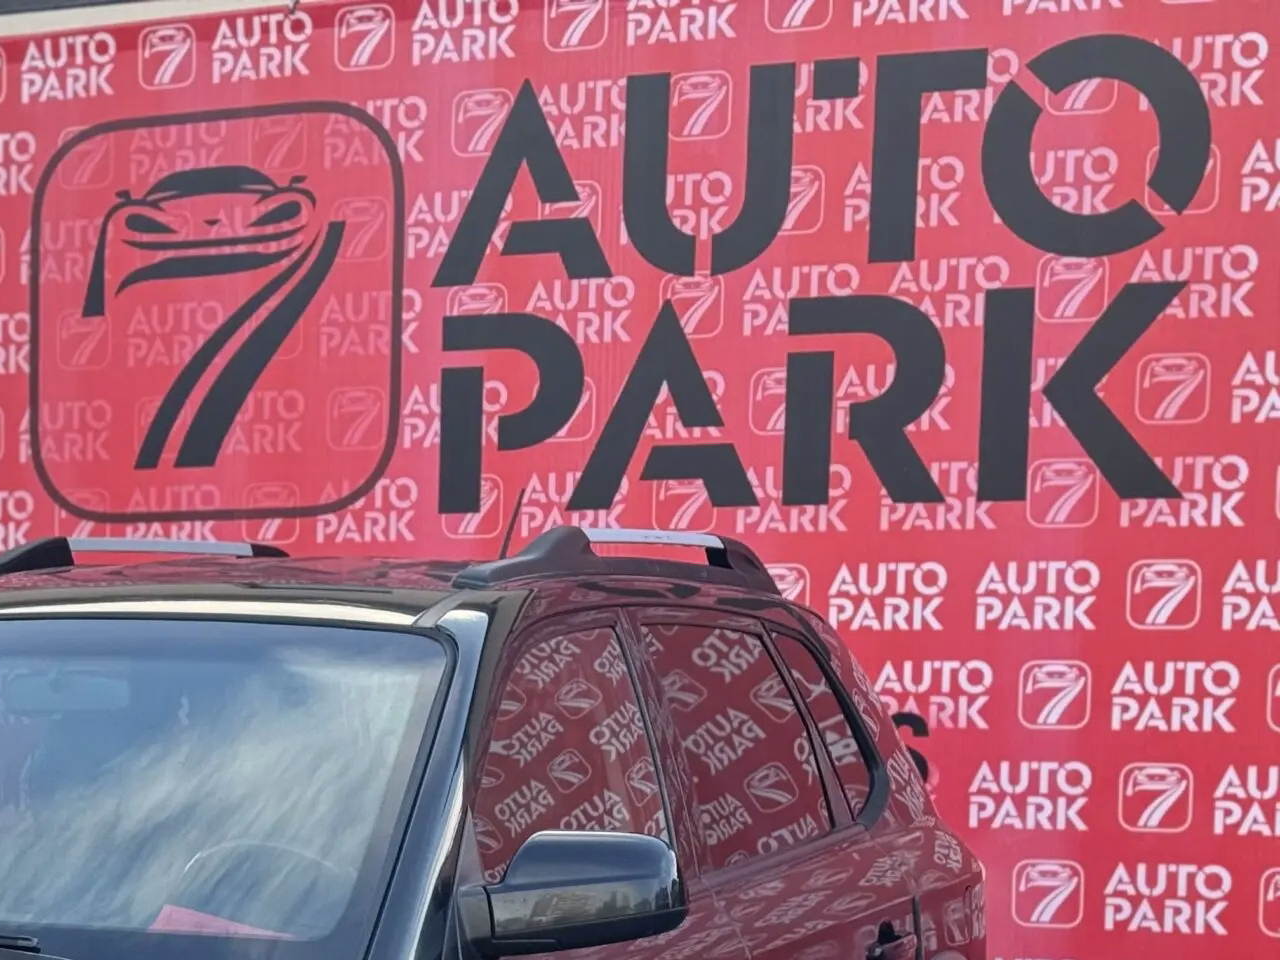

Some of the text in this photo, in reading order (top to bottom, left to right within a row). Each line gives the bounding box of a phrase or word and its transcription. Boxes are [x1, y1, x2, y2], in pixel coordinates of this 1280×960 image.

[211, 11, 313, 52] AUTO
[411, 0, 519, 32] AUTO
[626, 4, 737, 46] PARK
[20, 32, 116, 73] AUTO
[212, 42, 310, 84] PARK
[413, 24, 516, 66] PARK
[21, 63, 114, 104] PARK
[430, 34, 1212, 287] AUTO
[888, 256, 1010, 293] AUTO
[1129, 244, 1259, 283] AUTO
[524, 276, 635, 312] AUTO
[743, 263, 860, 301] AUTO
[438, 280, 1190, 514] PARK
[128, 485, 220, 513] AUTO
[736, 498, 848, 534] PARK
[880, 497, 997, 532] PARK
[1120, 492, 1246, 528] PARK
[317, 511, 415, 543] PARK
[828, 562, 947, 596] AUTO
[976, 560, 1100, 594] AUTO
[828, 597, 943, 630] PARK
[976, 596, 1096, 630] PARK
[874, 660, 993, 694] AUTO
[1111, 661, 1240, 696] AUTO
[1112, 697, 1236, 732] PARK
[969, 761, 1092, 795] AUTO
[969, 796, 1088, 831] PARK
[1104, 863, 1232, 899] AUTO
[1105, 897, 1228, 935] PARK
